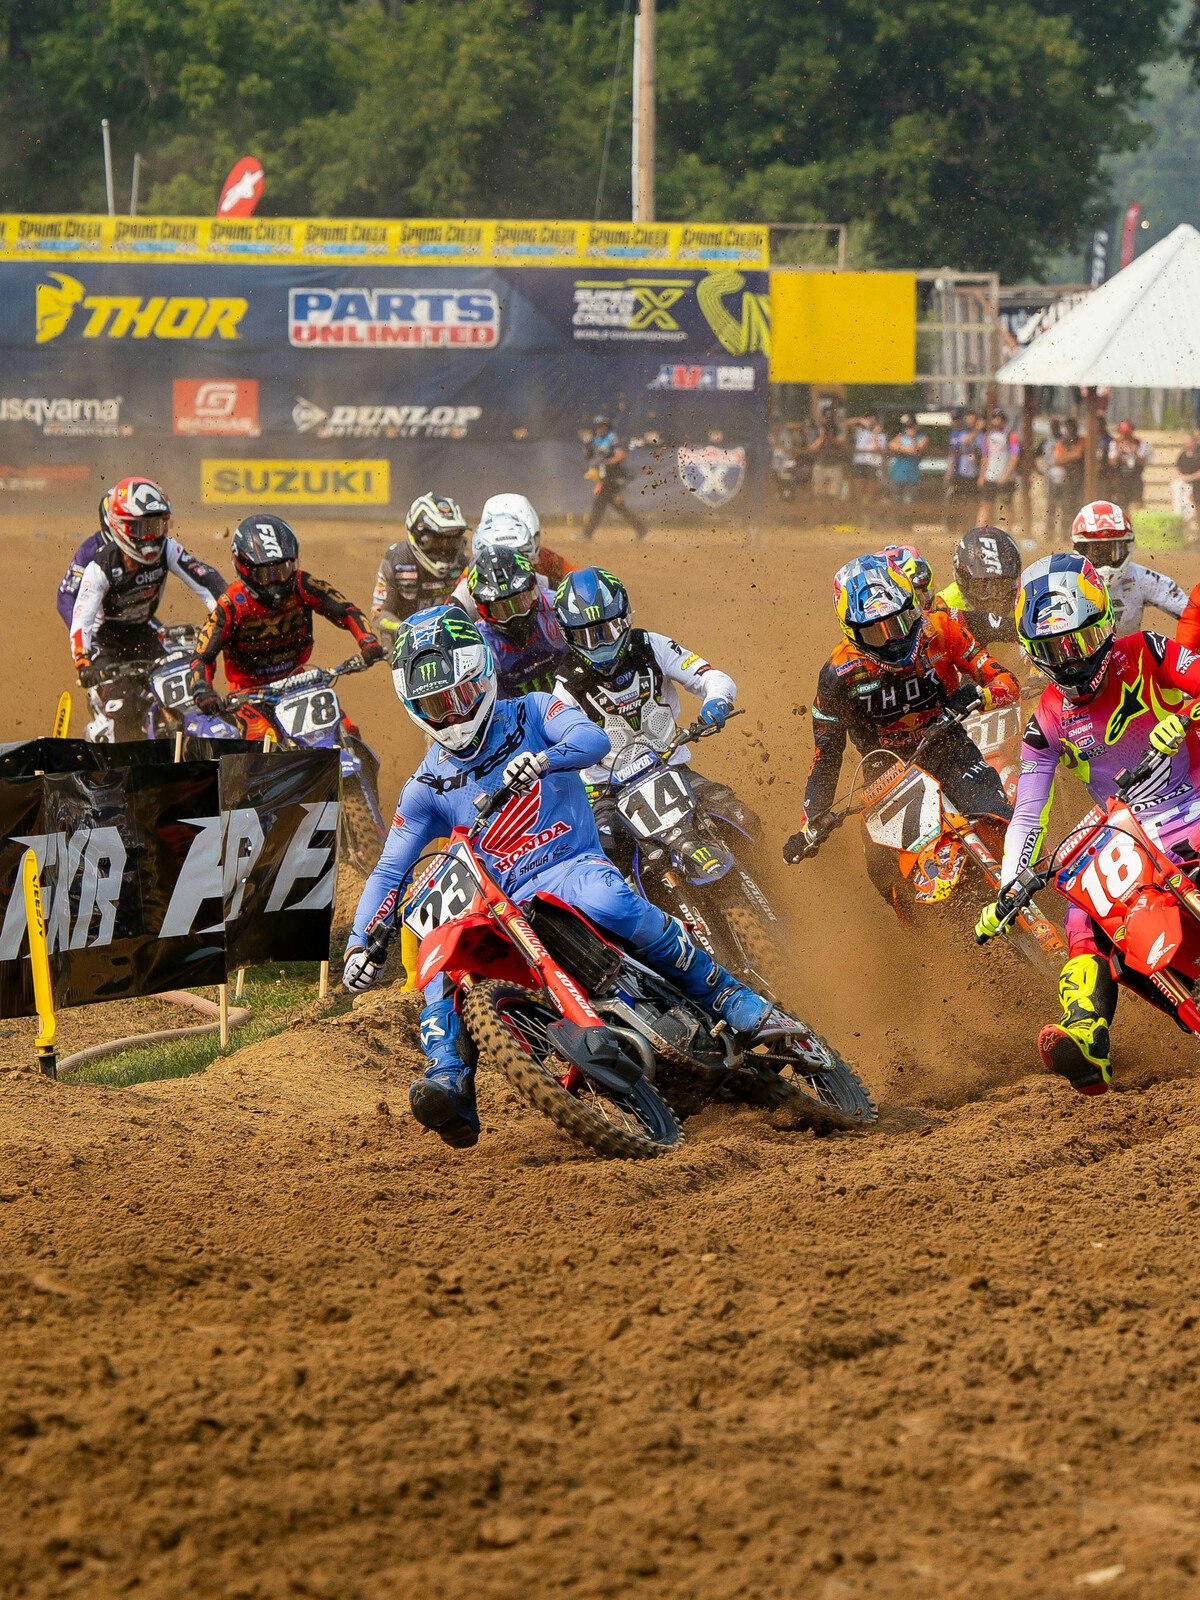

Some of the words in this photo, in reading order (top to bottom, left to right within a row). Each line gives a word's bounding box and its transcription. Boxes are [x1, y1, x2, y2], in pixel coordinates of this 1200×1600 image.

[83, 297, 248, 339] THOR
[292, 293, 494, 322] PARTS
[293, 325, 494, 342] UNLIMITED
[330, 406, 482, 427] DUNLOP
[214, 469, 373, 494] SUZUKI
[256, 524, 283, 558] FXR
[284, 692, 336, 737] 78
[617, 699, 642, 714] THOR
[1069, 722, 1093, 738] SHOWA
[625, 773, 690, 834] 14
[880, 779, 926, 849] 7
[494, 821, 572, 874] HONDA
[519, 855, 549, 877] SHOWA
[1016, 827, 1042, 874] HONDA
[419, 862, 477, 928] 23
[1081, 833, 1143, 917] 18
[364, 888, 398, 934] HONDA
[679, 903, 715, 955] DUNLOP
[554, 970, 598, 1019] DUNLOP
